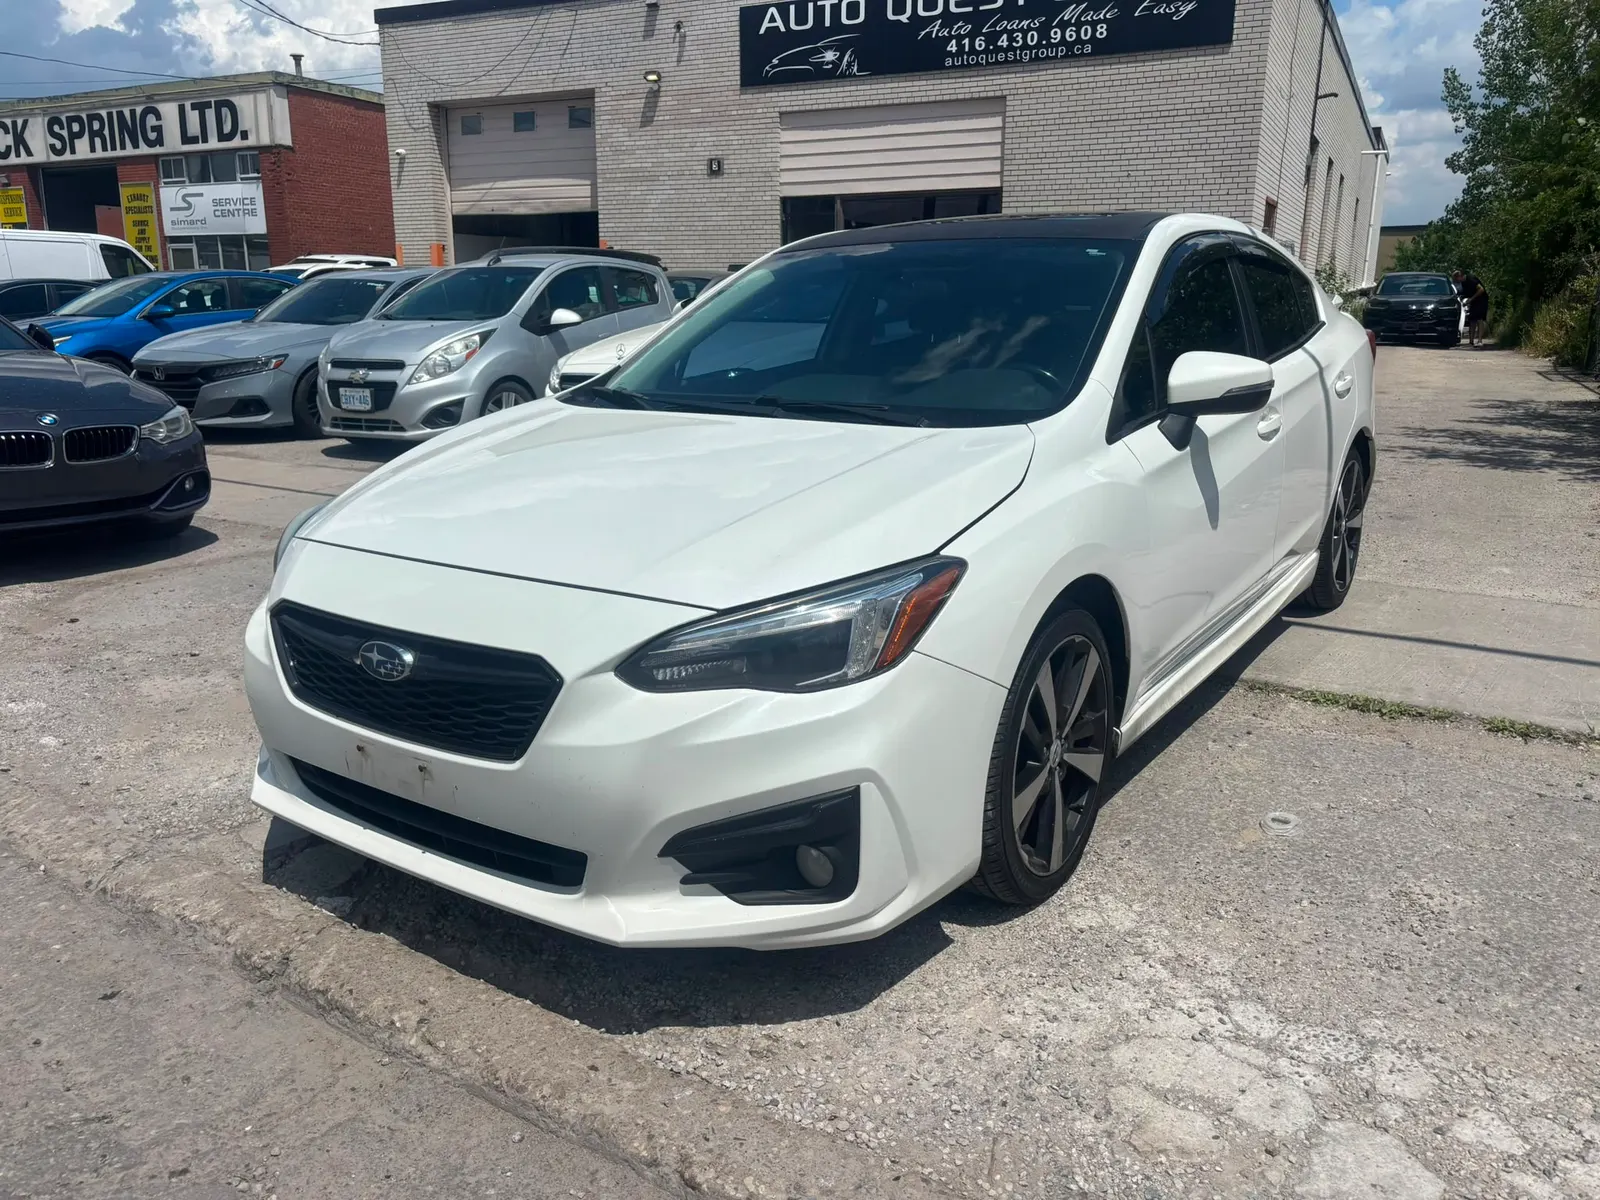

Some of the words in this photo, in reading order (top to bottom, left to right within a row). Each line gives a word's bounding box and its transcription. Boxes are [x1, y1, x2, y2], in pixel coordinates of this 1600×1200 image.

[758, 0, 865, 35] AUTO
[917, 19, 972, 40] Auto
[981, 13, 1046, 33] Loans
[1052, 2, 1120, 26] Made
[1134, 0, 1198, 21] Easy
[946, 24, 1108, 53] 416.430.9608
[944, 44, 1092, 66] autoquestgroup.ca
[46, 105, 164, 157] SPRING
[178, 99, 249, 146] LTD.
[126, 192, 150, 203] EXHAUST
[211, 196, 257, 207] SERVICE
[125, 205, 154, 215] SPECIALISTS
[212, 207, 258, 218] CENTRE
[132, 219, 150, 228] SERVICE
[170, 217, 207, 226] simard
